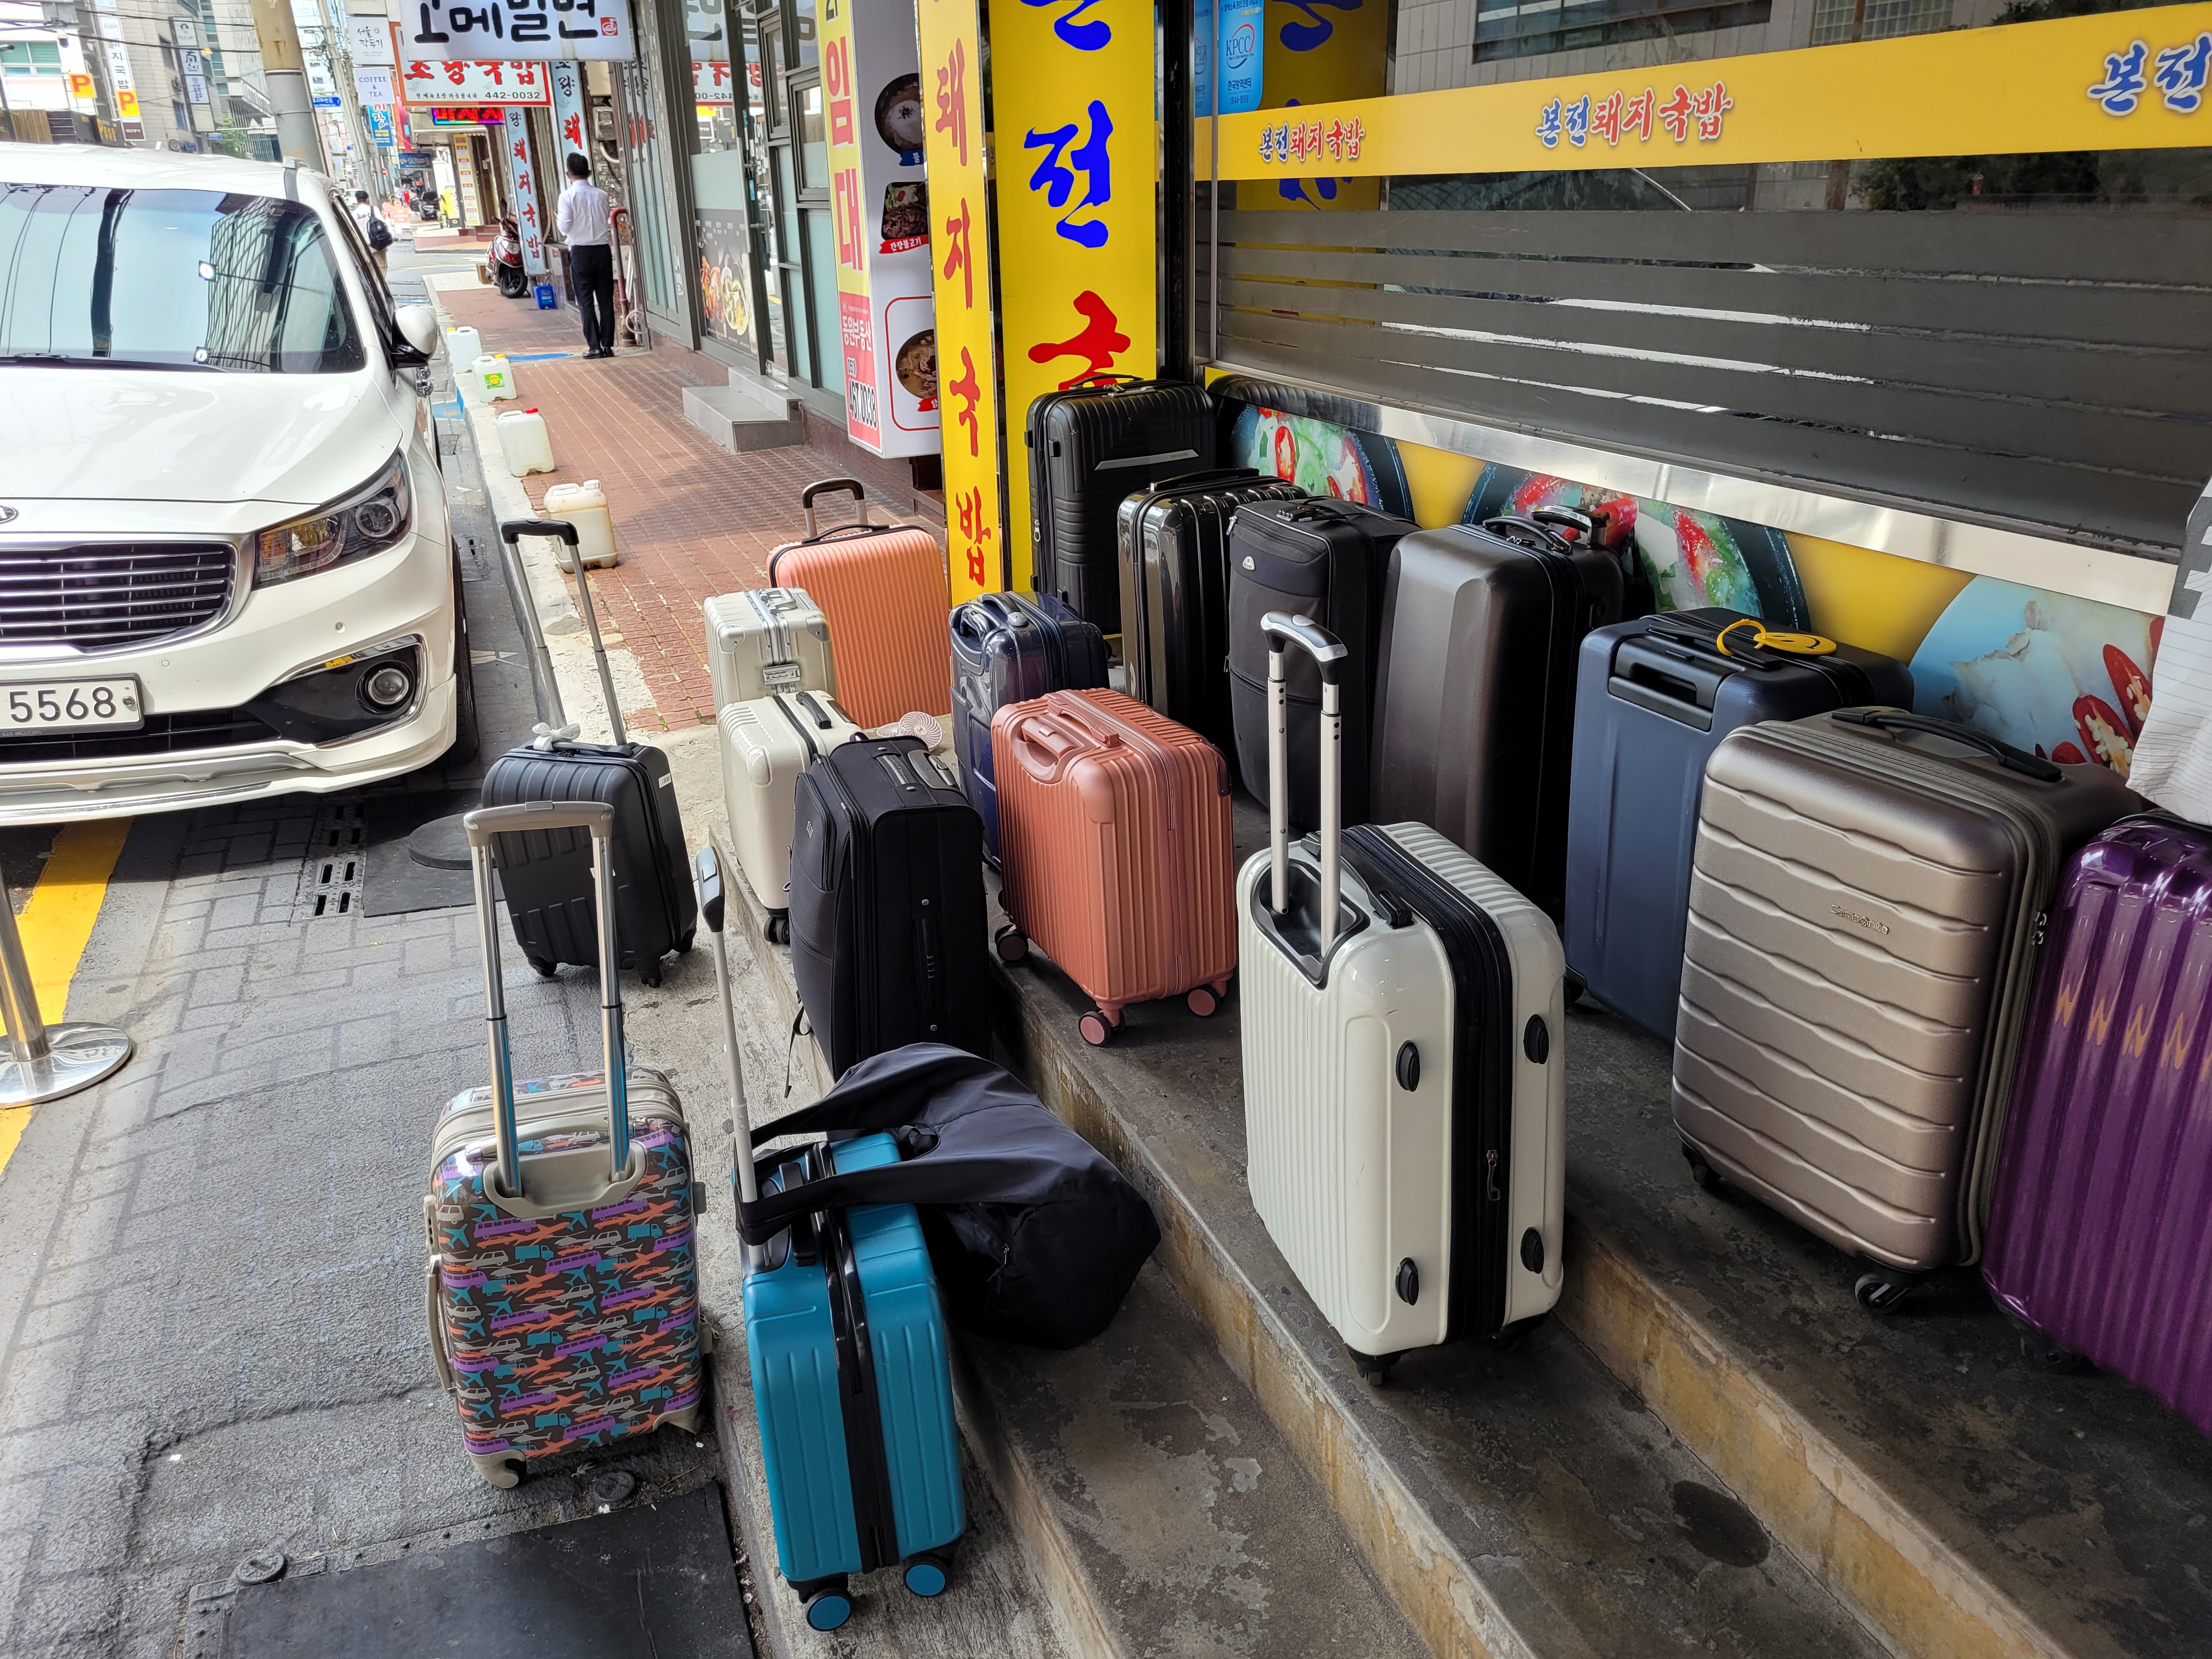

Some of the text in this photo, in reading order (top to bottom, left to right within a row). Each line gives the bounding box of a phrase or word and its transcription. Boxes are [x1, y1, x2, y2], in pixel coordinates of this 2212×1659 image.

[1226, 36, 1250, 57] KPCC
[71, 75, 91, 92] P
[118, 92, 136, 111] P
[826, 36, 863, 271] 임대
[514, 137, 542, 259] 돼지국밥
[890, 237, 922, 251] 간장불고기
[935, 38, 991, 587] 돼지국밥
[843, 315, 872, 352] 동원부동산
[9, 686, 117, 723] 5568
[927, 955, 935, 978] ELLE
